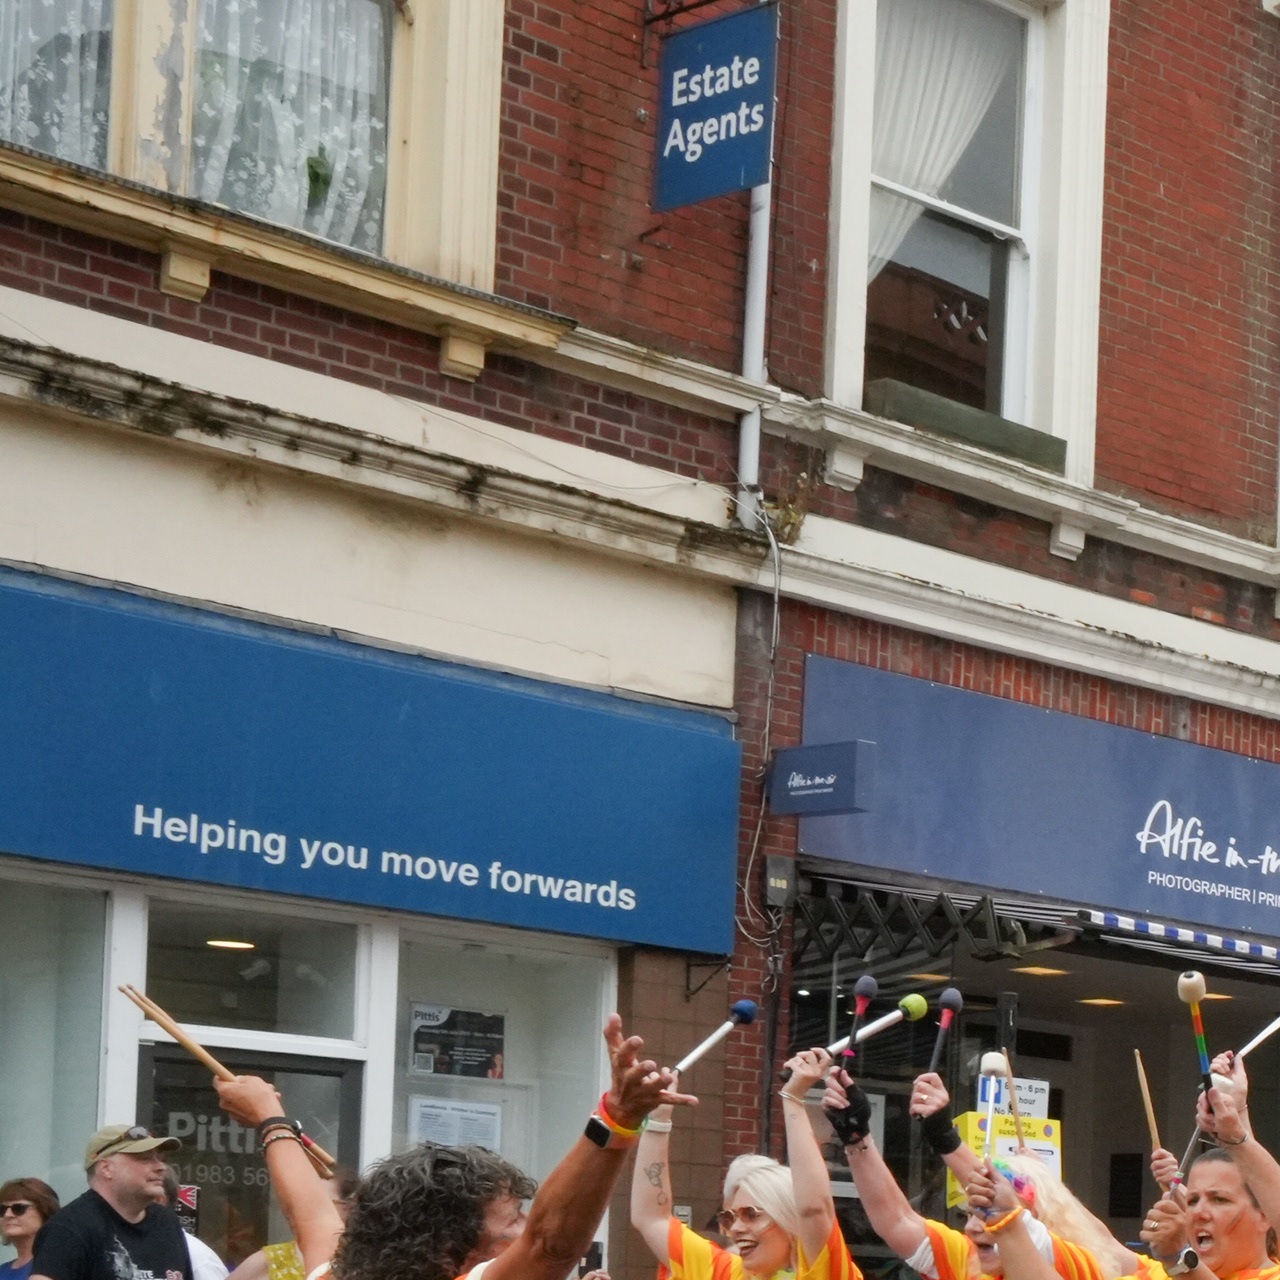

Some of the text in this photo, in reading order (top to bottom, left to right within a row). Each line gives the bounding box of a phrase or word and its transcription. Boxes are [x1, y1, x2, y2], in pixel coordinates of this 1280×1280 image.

[672, 55, 760, 107] Estate
[663, 101, 764, 163] Agents
[1135, 800, 1220, 863] Alfie
[133, 804, 637, 911] Helping you move forwards
[1147, 870, 1251, 902] PHOTOGRAPHER
[413, 1010, 440, 1022] Pittis
[1018, 1096, 1036, 1105] hour
[168, 1111, 264, 1154] Pitti
[998, 1128, 1037, 1138] suspded
[1004, 1118, 1031, 1129] Paing
[172, 1163, 235, 1185] 01983
